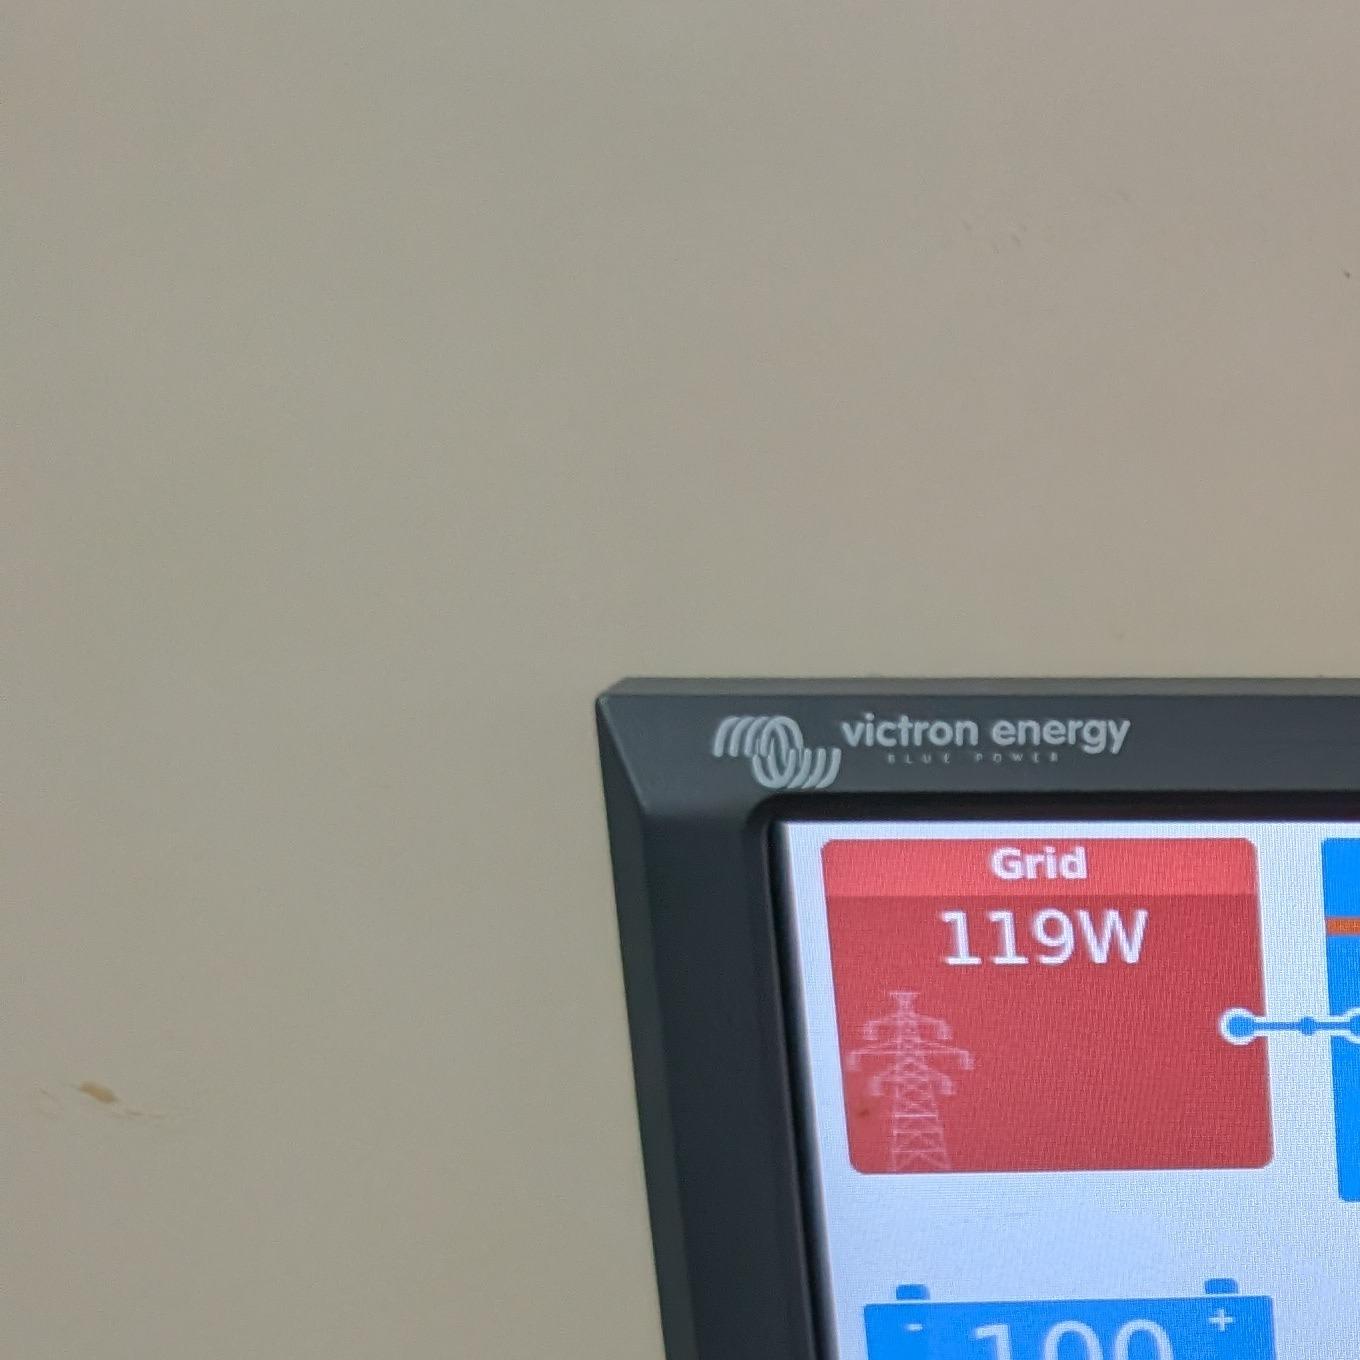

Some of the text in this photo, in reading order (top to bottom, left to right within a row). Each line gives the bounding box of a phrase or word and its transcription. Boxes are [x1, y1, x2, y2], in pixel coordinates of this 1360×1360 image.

[842, 713, 1132, 755] victron energy
[988, 845, 1088, 880] Grid
[939, 908, 1149, 966] 119W
